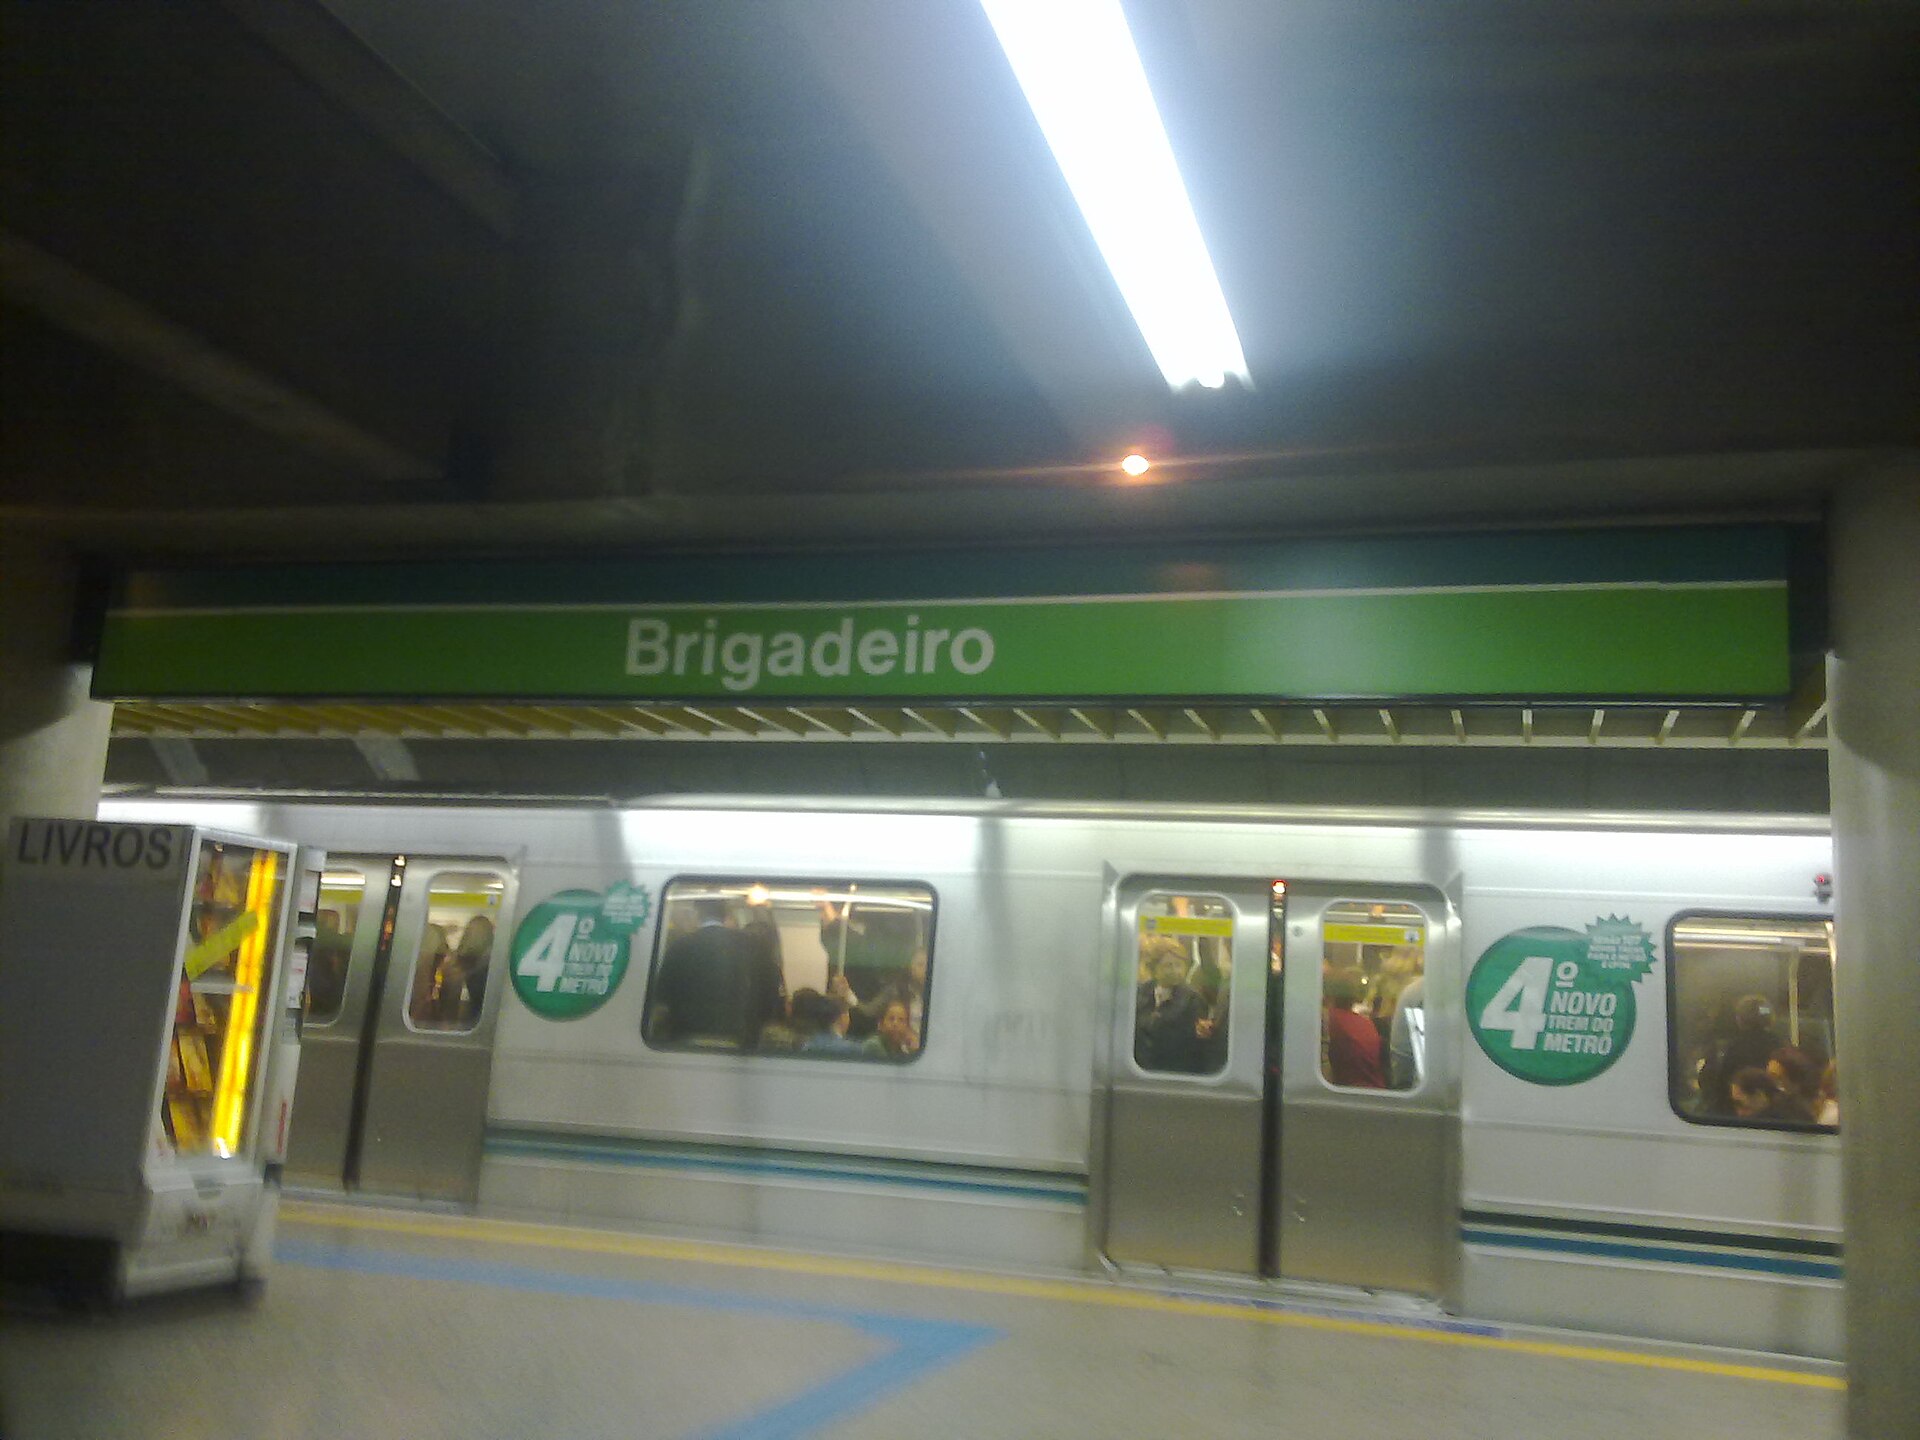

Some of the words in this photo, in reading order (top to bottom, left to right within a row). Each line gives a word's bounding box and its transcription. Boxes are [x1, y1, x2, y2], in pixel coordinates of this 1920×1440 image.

[626, 615, 995, 691] Brigadeiro
[18, 821, 172, 870] LIVROS
[1550, 991, 1617, 1016] NOVO
[1548, 1015, 1589, 1031] TREM
[1593, 1016, 1614, 1032] DO
